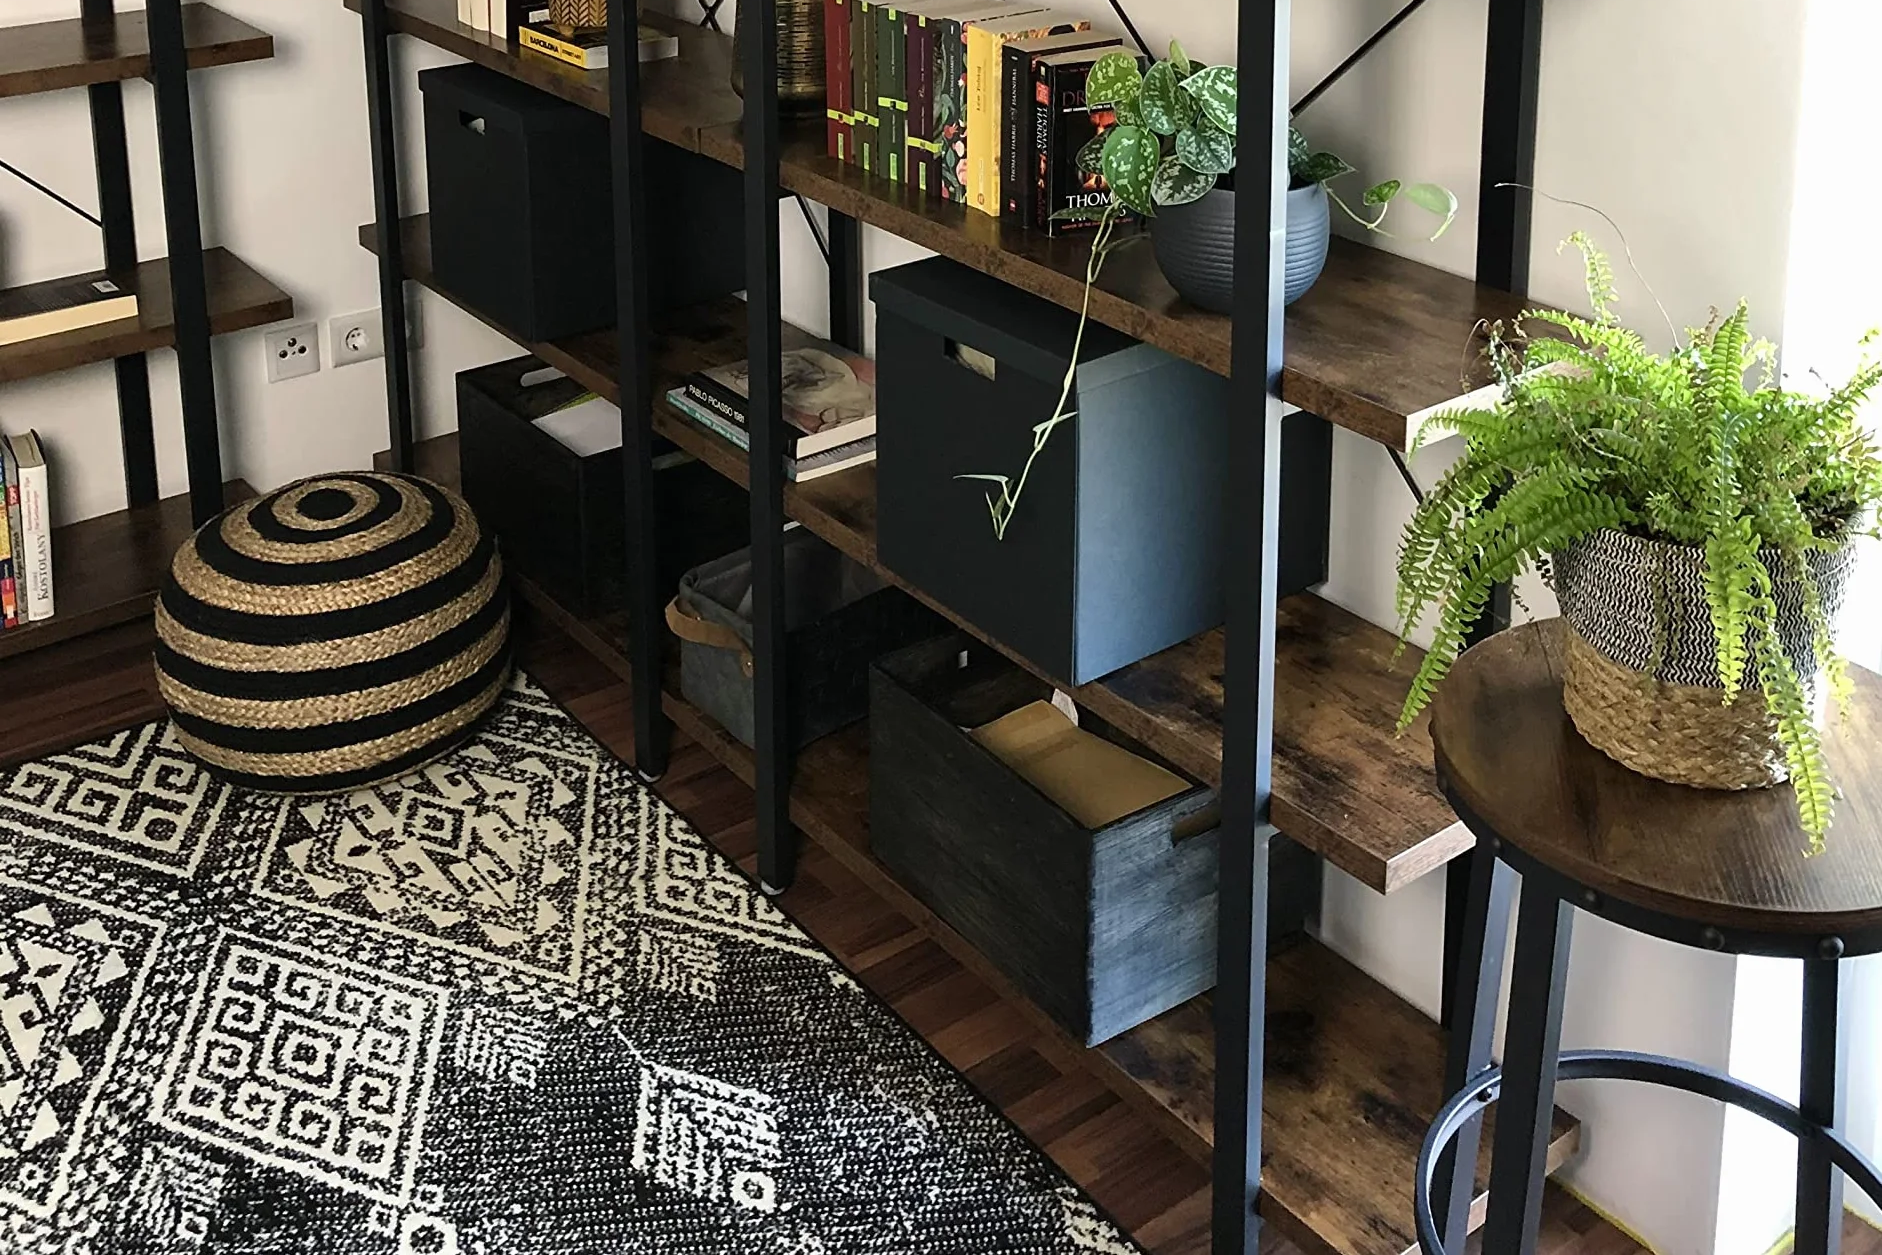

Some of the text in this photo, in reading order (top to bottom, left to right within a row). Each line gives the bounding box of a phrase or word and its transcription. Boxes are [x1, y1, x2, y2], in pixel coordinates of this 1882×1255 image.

[529, 35, 559, 53] BARCELONA
[1041, 107, 1049, 155] THOMAS
[1065, 192, 1113, 209] THOM
[688, 384, 708, 402] PABLO
[707, 395, 733, 417] PICASSO
[37, 534, 49, 601] KOSTOLANY
